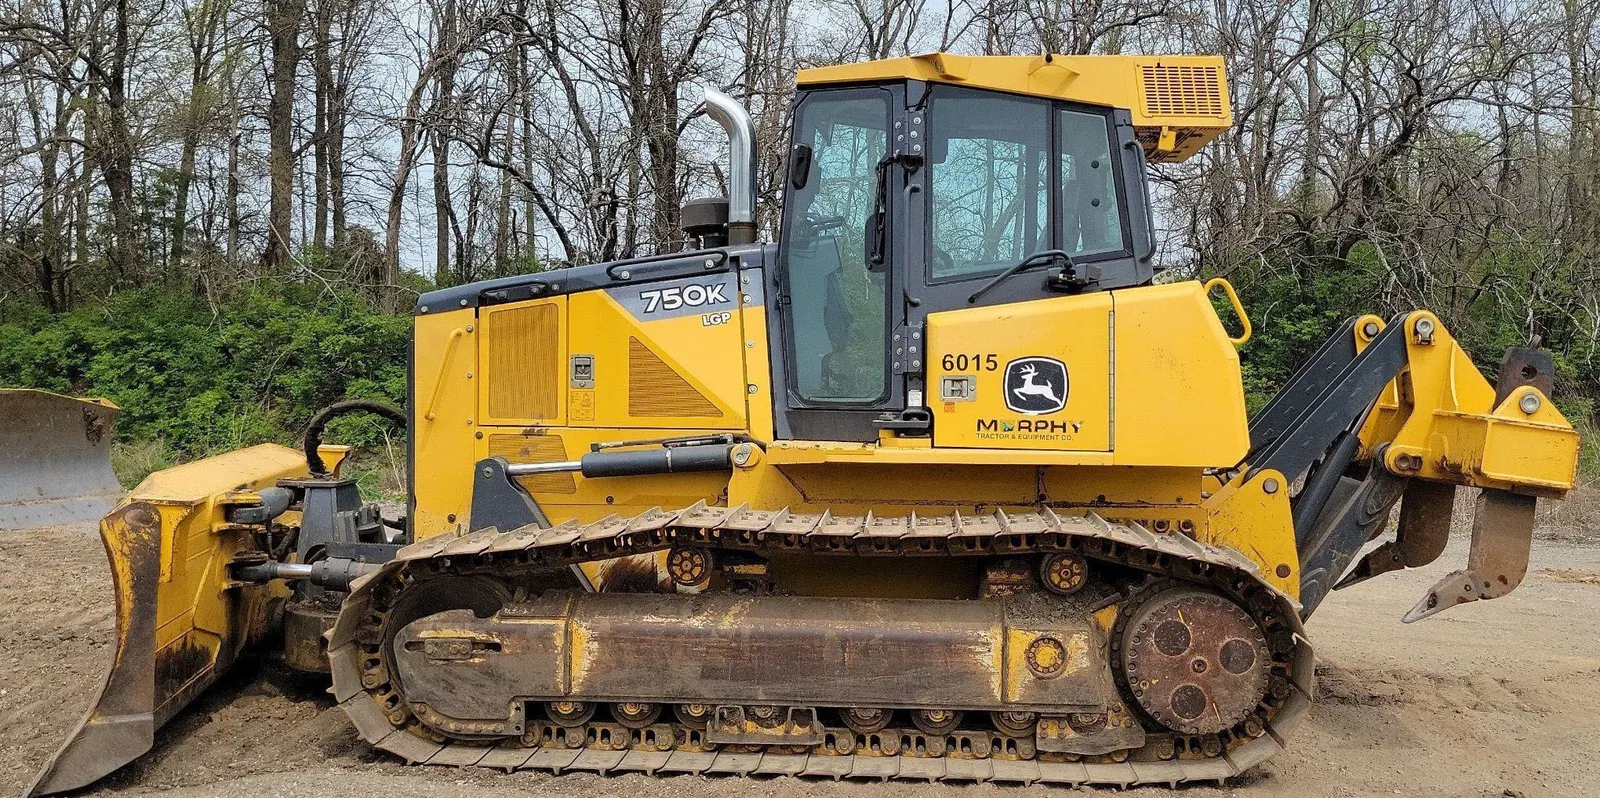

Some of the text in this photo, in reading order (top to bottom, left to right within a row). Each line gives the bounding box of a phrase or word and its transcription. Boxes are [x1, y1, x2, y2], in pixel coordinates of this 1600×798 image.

[640, 283, 730, 314] 750K
[702, 312, 731, 326] LGP
[942, 354, 998, 371] 6015
